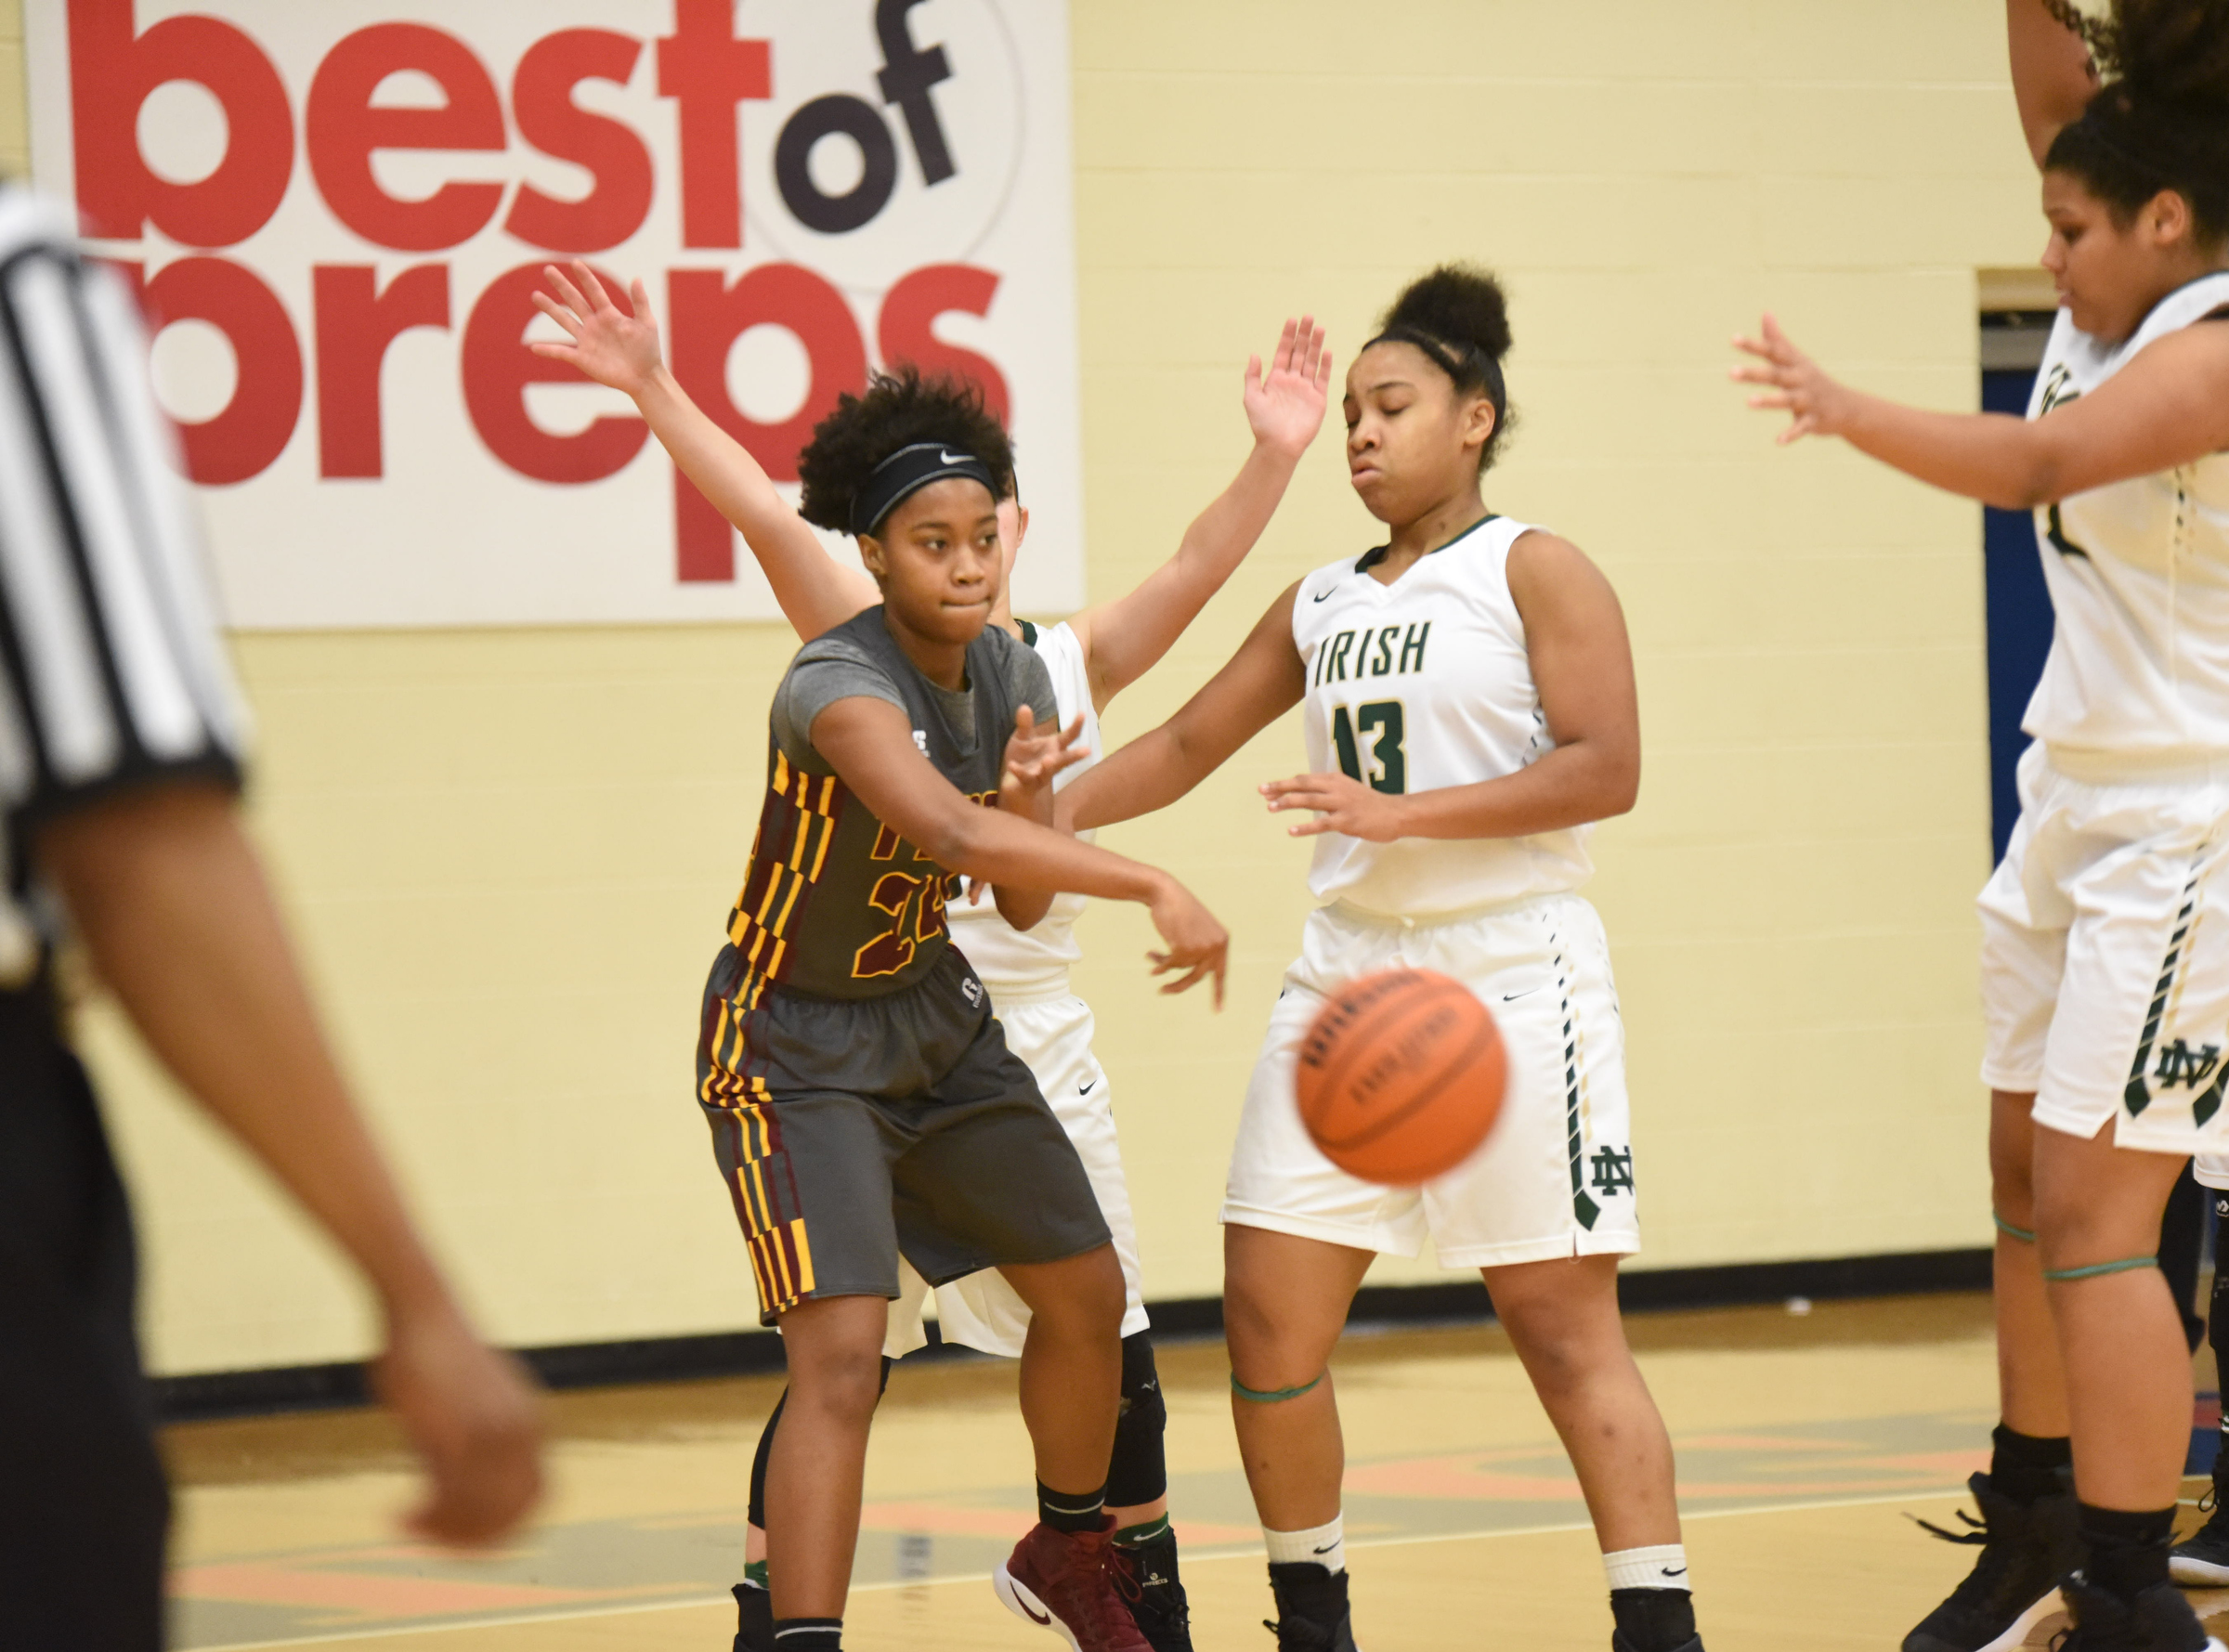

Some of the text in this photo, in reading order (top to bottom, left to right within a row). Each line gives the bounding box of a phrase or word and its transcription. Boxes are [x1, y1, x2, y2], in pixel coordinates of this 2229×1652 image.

[65, 0, 958, 254] best of
[1314, 620, 1433, 689] IRISH
[1329, 696, 1408, 797] 13
